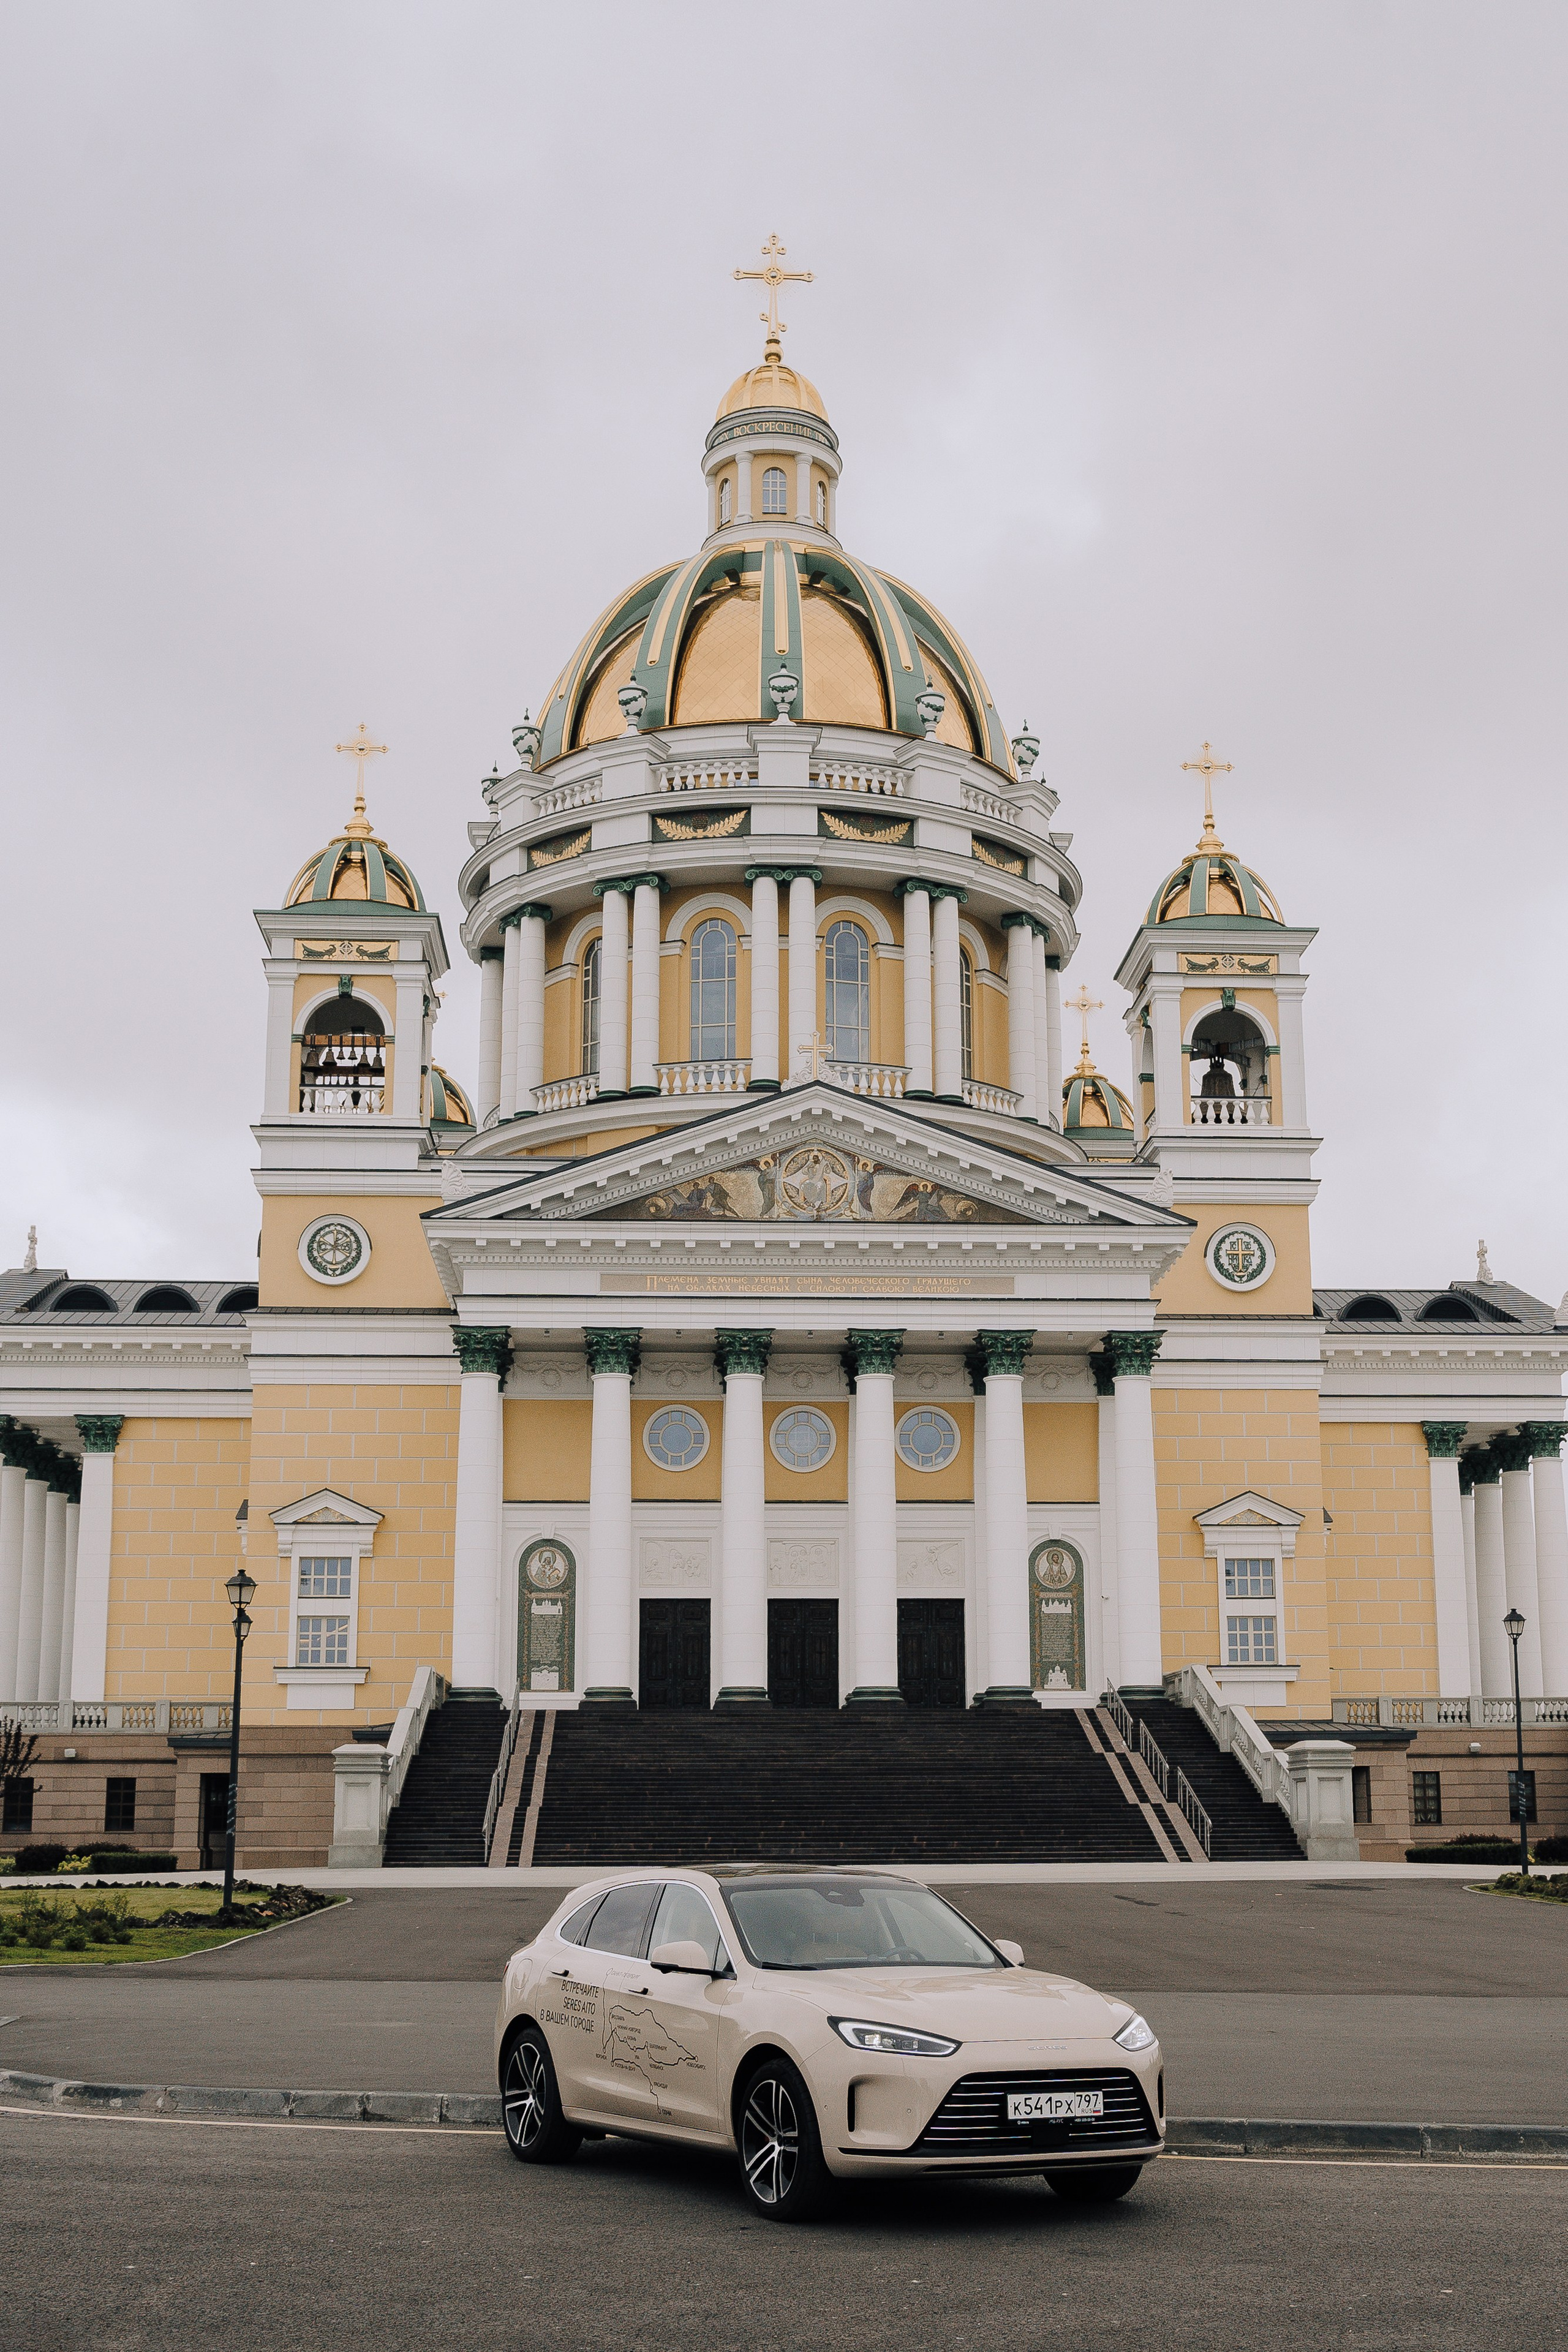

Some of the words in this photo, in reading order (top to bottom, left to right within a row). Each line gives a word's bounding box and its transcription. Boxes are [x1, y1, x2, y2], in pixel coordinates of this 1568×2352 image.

[733, 421, 813, 437] ВОСКРЕСЕНИЕ
[561, 1979, 600, 1998] ВСТРЕЧАЙТЕ
[563, 1996, 581, 2012] SERES
[581, 2001, 596, 2015] AITO
[540, 2008, 545, 2021] В
[545, 2010, 570, 2027] ВАШЕМ
[570, 2015, 595, 2034] ГОРОДЕ
[1076, 2094, 1099, 2108] 797
